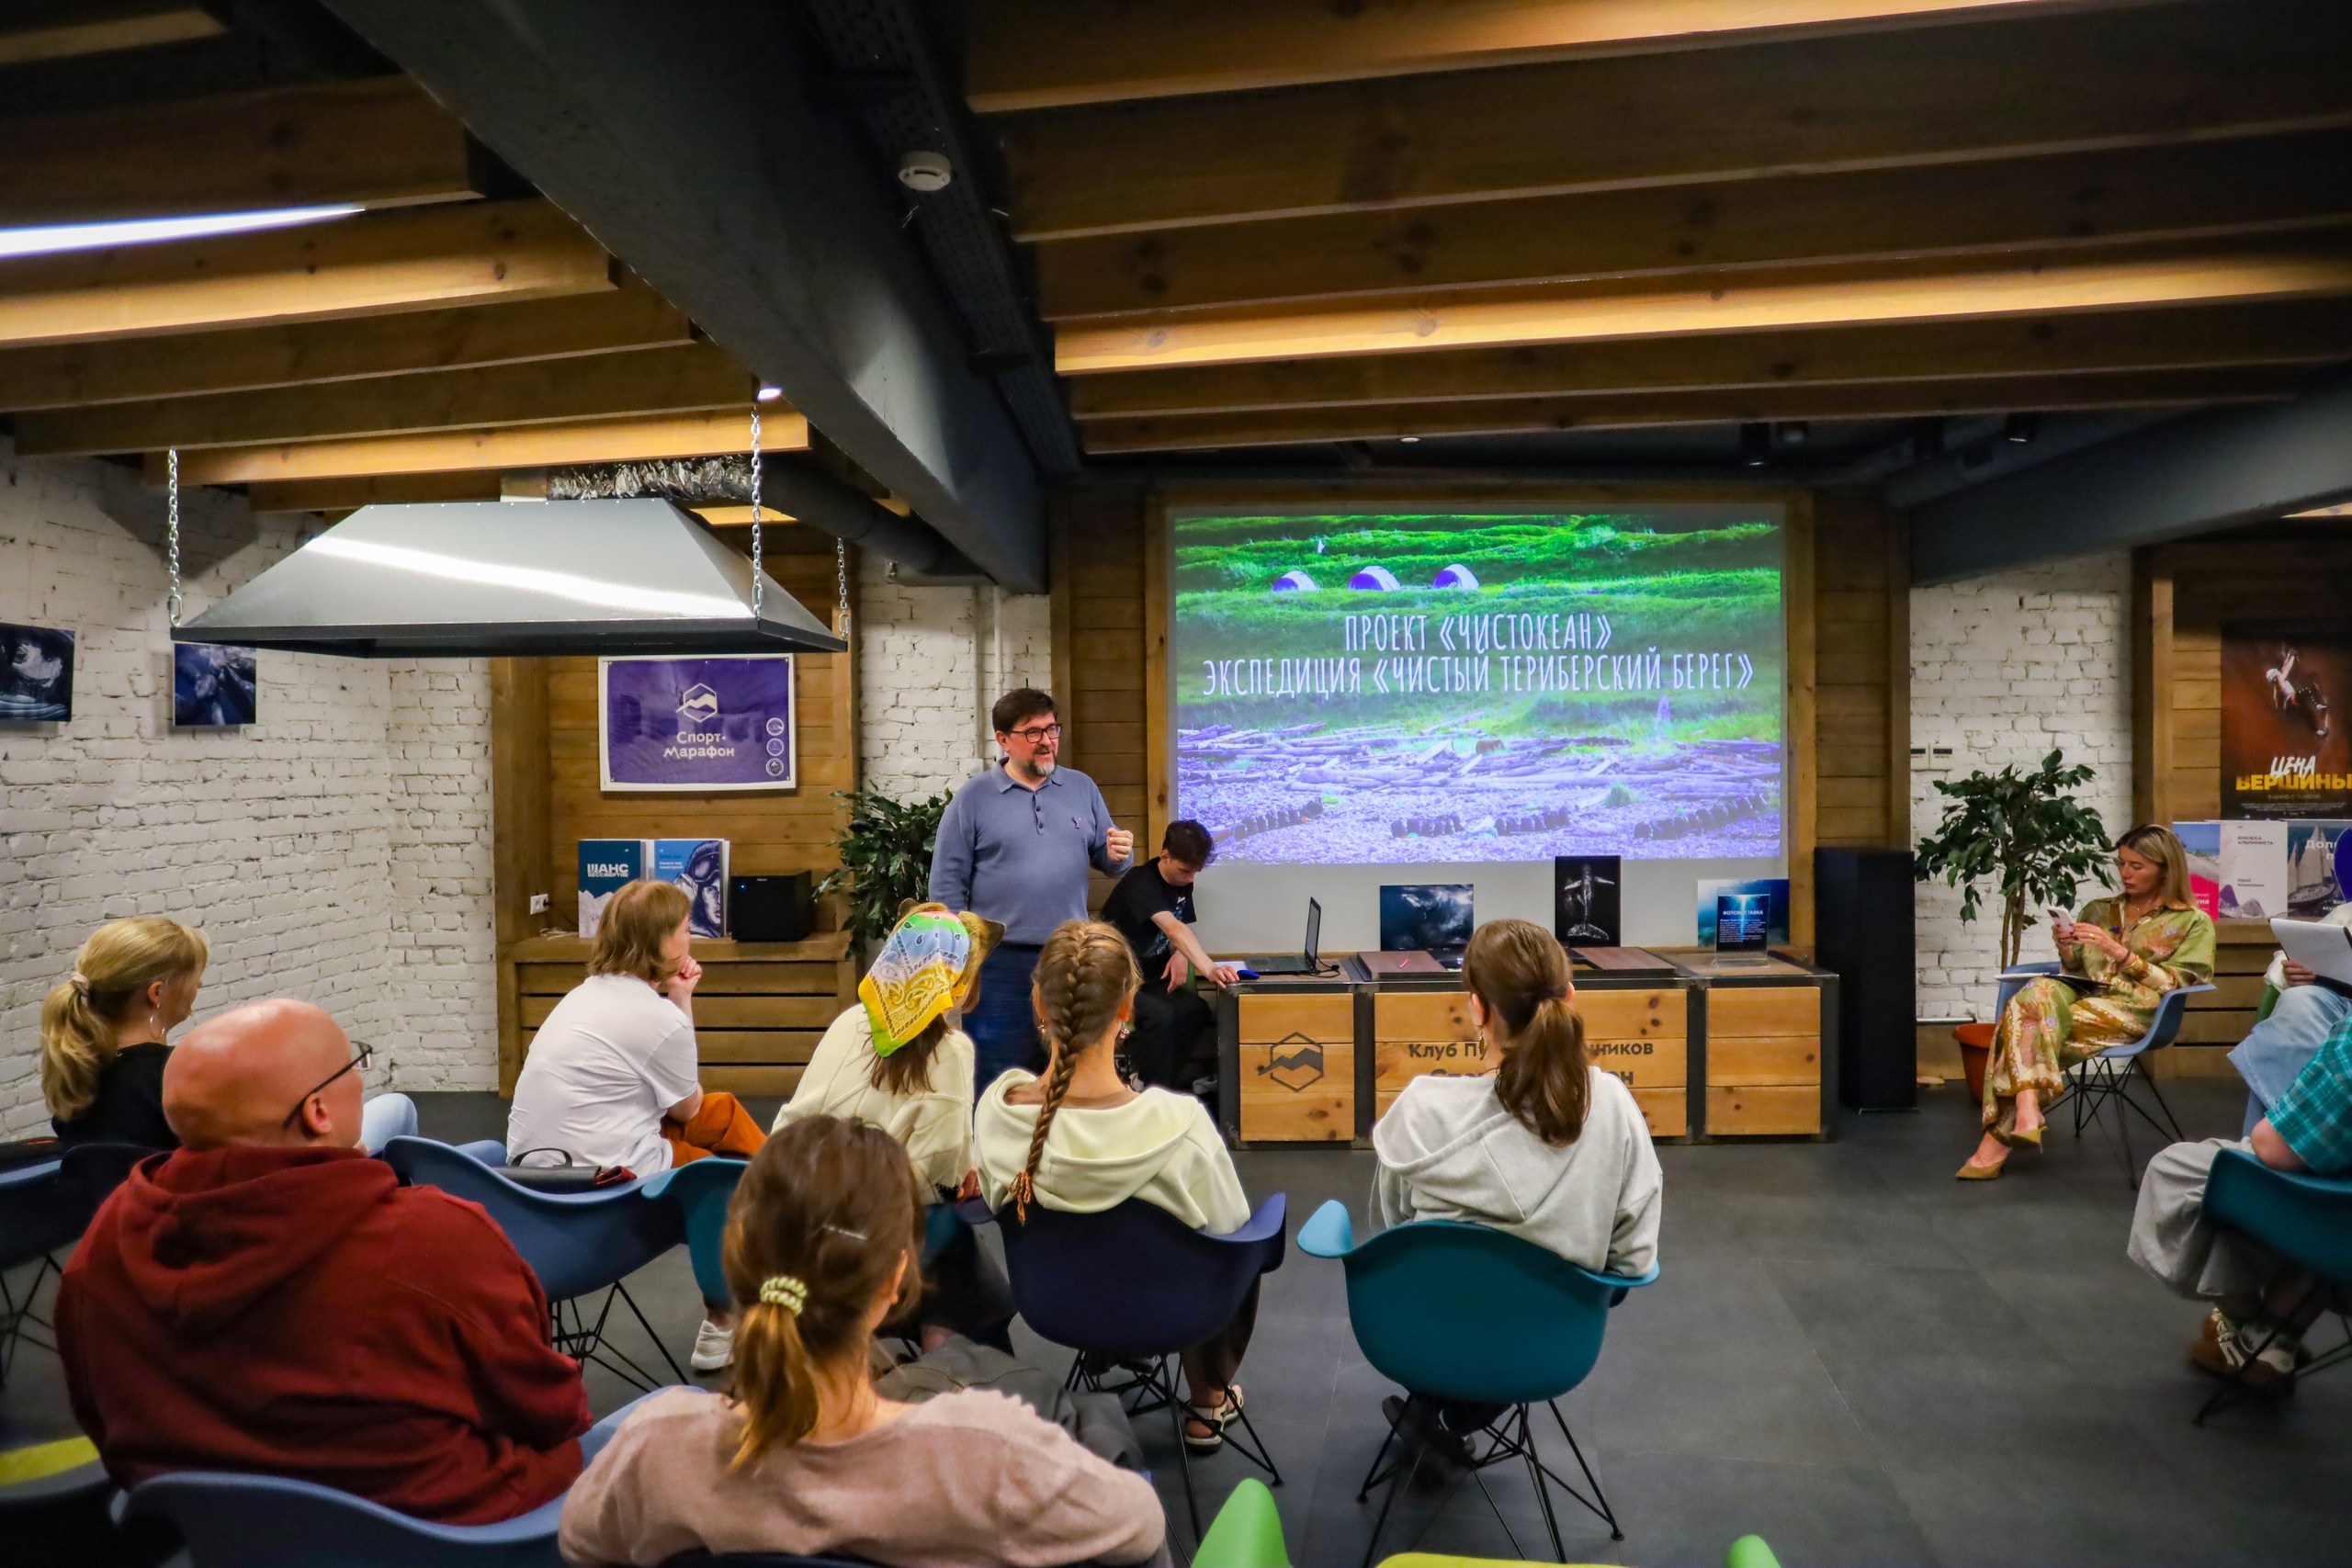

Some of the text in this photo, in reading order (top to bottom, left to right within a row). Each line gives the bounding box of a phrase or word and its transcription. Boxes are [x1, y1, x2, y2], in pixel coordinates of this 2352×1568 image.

[1345, 613, 1611, 651] ПРОЕКТ «ЧИСТОКЕАН»
[1203, 646, 1753, 700] ЭКСПЕДИЦИЯ «ЧИСТЫЙ ТЕРИБЕРСКИЙ БЕРЕГ»
[662, 745, 734, 760] Марафон
[2270, 755, 2315, 779] ЦЕНА
[587, 863, 629, 874] ШАНС
[1408, 1043, 1457, 1061] Клуб
